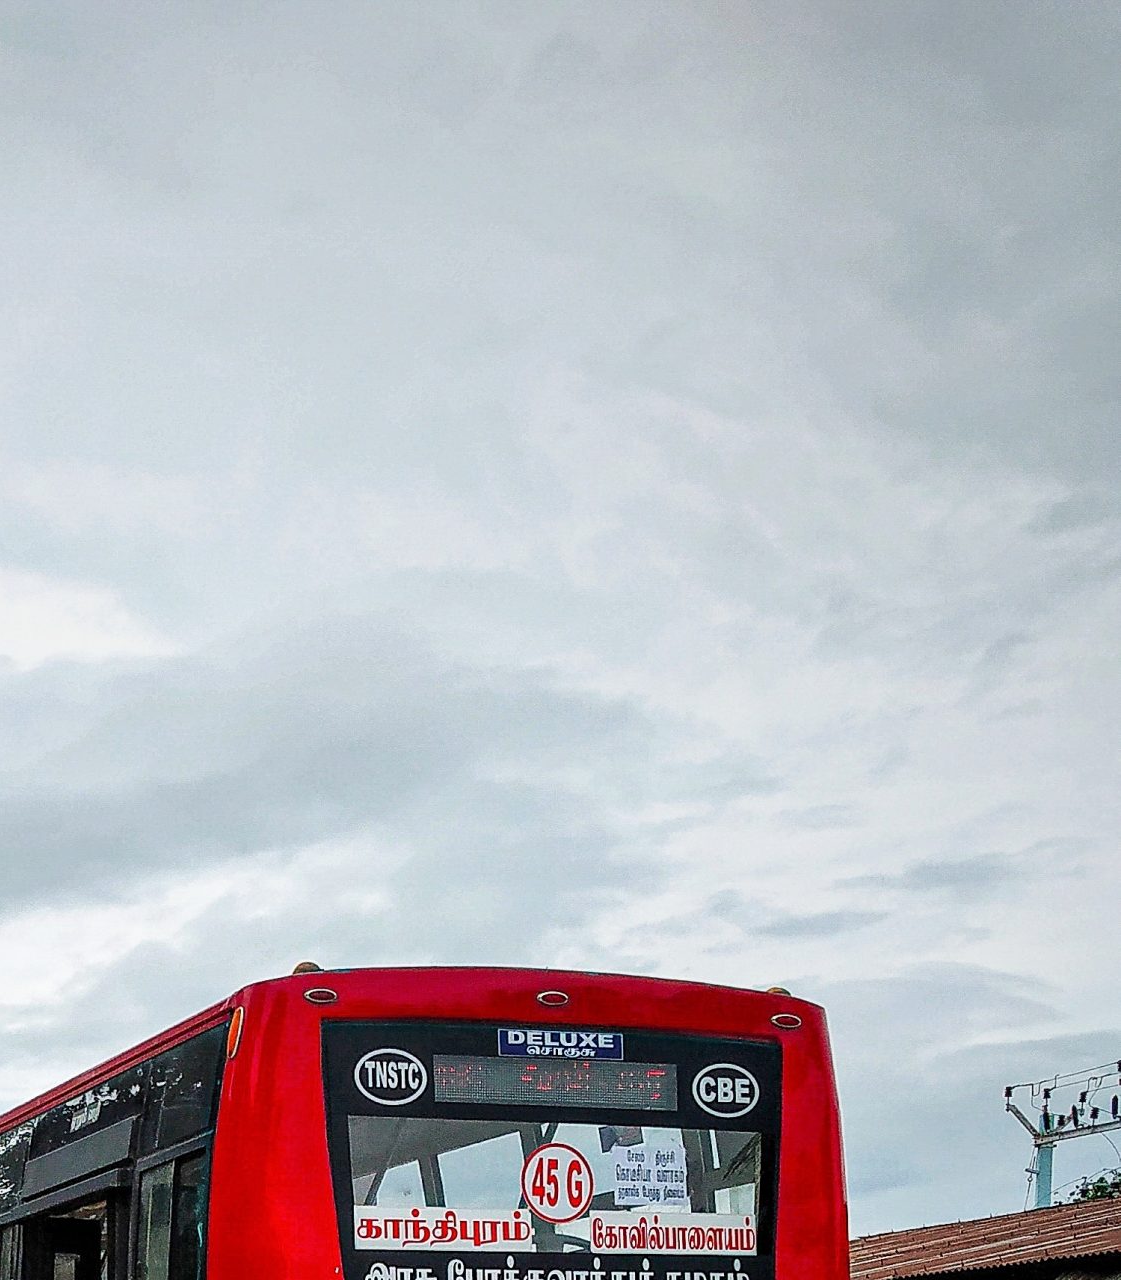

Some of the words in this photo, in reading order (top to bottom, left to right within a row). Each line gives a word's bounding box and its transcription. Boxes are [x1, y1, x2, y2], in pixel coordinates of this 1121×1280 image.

[508, 1030, 614, 1048] DELUXE
[526, 1045, 596, 1058] சொகுசு
[364, 1061, 420, 1090] TNSTC
[699, 1076, 751, 1104] CBE
[531, 1157, 559, 1207] 45
[567, 1159, 583, 1208] G
[356, 1208, 531, 1248] காந்திபுரம்
[592, 1214, 756, 1251] கோவில்பாளையம்
